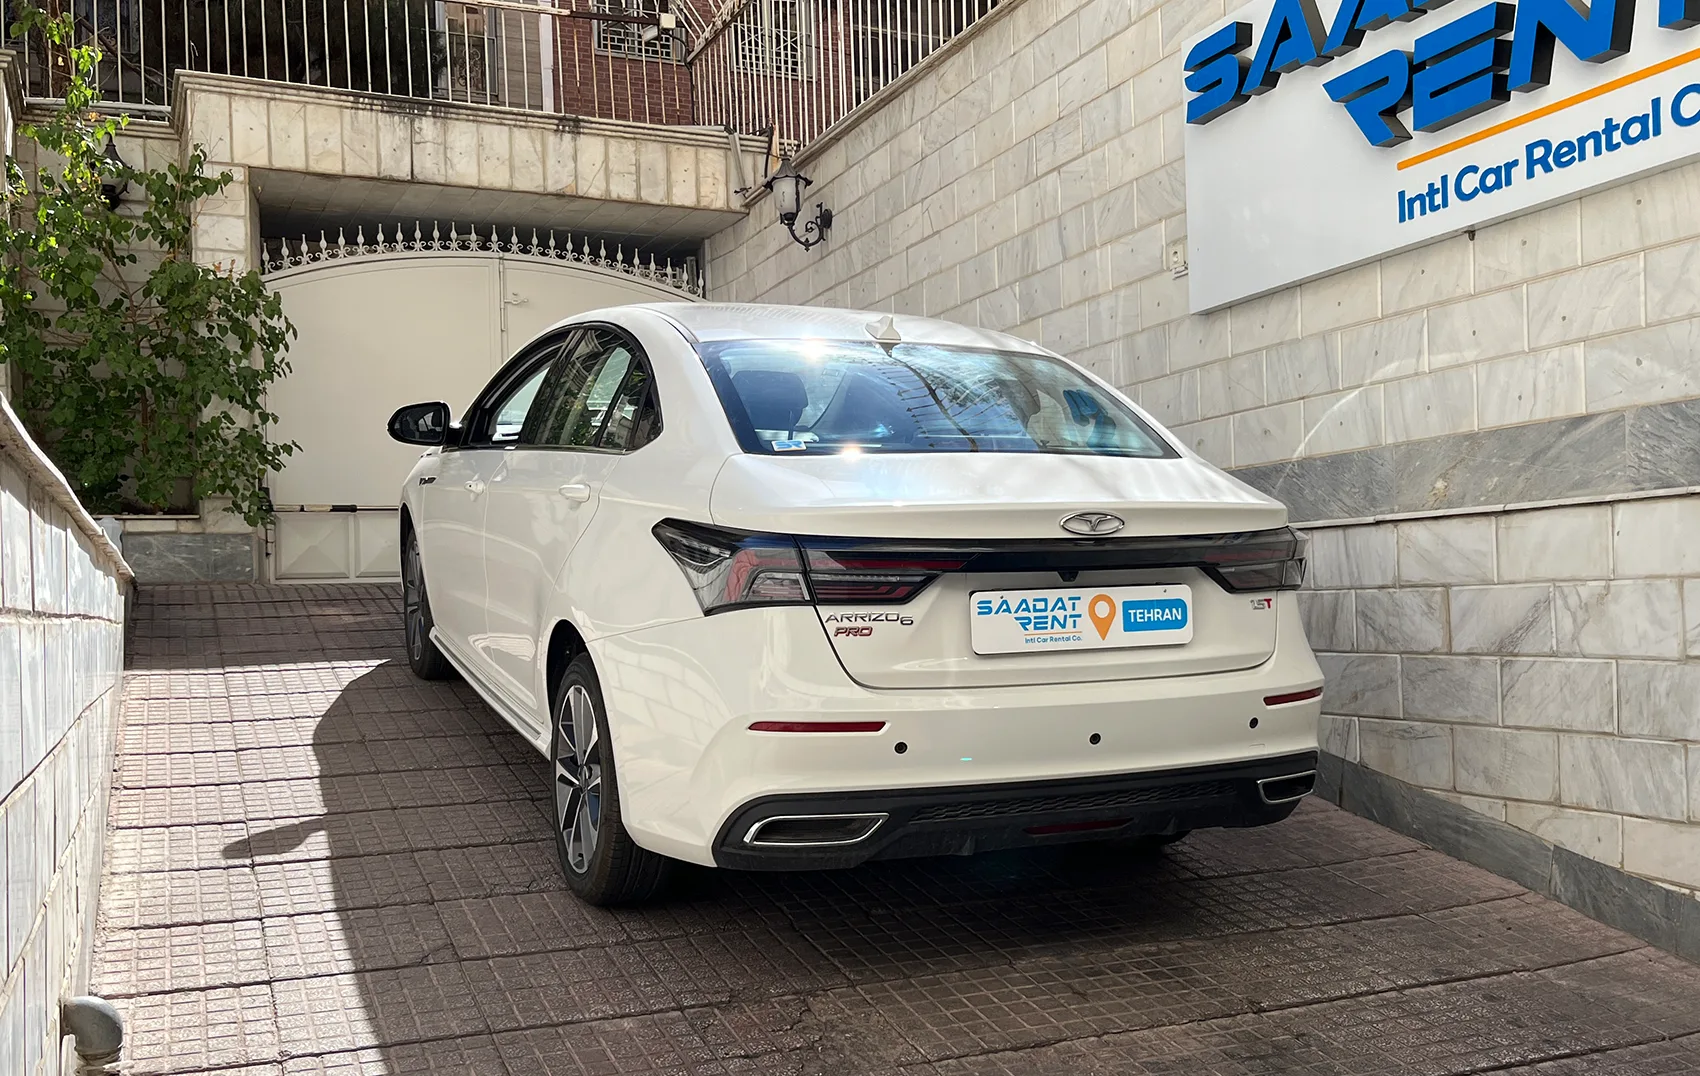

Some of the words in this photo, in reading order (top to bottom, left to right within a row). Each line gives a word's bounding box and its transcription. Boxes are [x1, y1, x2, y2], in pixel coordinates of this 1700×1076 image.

[1322, 0, 1700, 147] REN
[1397, 174, 1449, 223] Intl
[1453, 158, 1519, 201] Car
[1525, 96, 1662, 180] Rental
[977, 596, 1081, 615] SAADAT
[1014, 614, 1082, 631] RENT
[1128, 608, 1182, 622] TEHRAN
[834, 626, 873, 637] PRO
[1050, 635, 1071, 643] Rental
